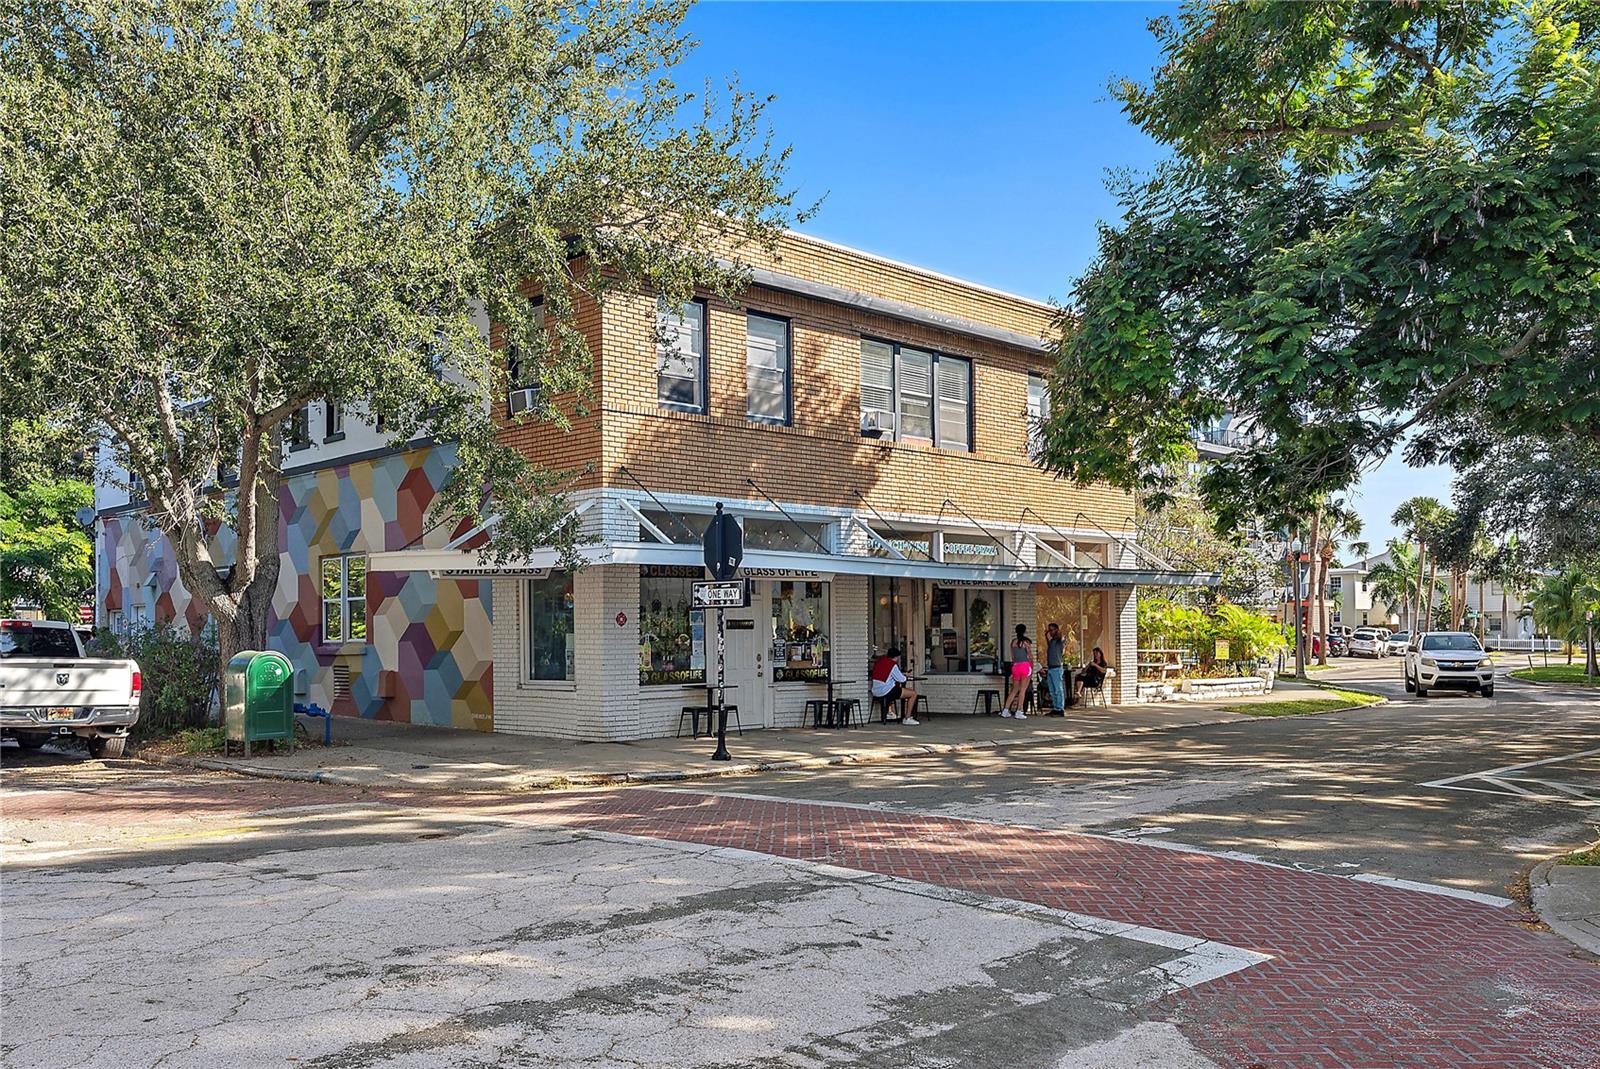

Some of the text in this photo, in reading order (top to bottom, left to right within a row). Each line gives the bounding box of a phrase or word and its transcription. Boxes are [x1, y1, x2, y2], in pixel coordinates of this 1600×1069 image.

[650, 565, 699, 577] CLASSES
[743, 567, 776, 576] GLASS
[778, 568, 792, 577] OF
[707, 588, 739, 599] ONE WAY
